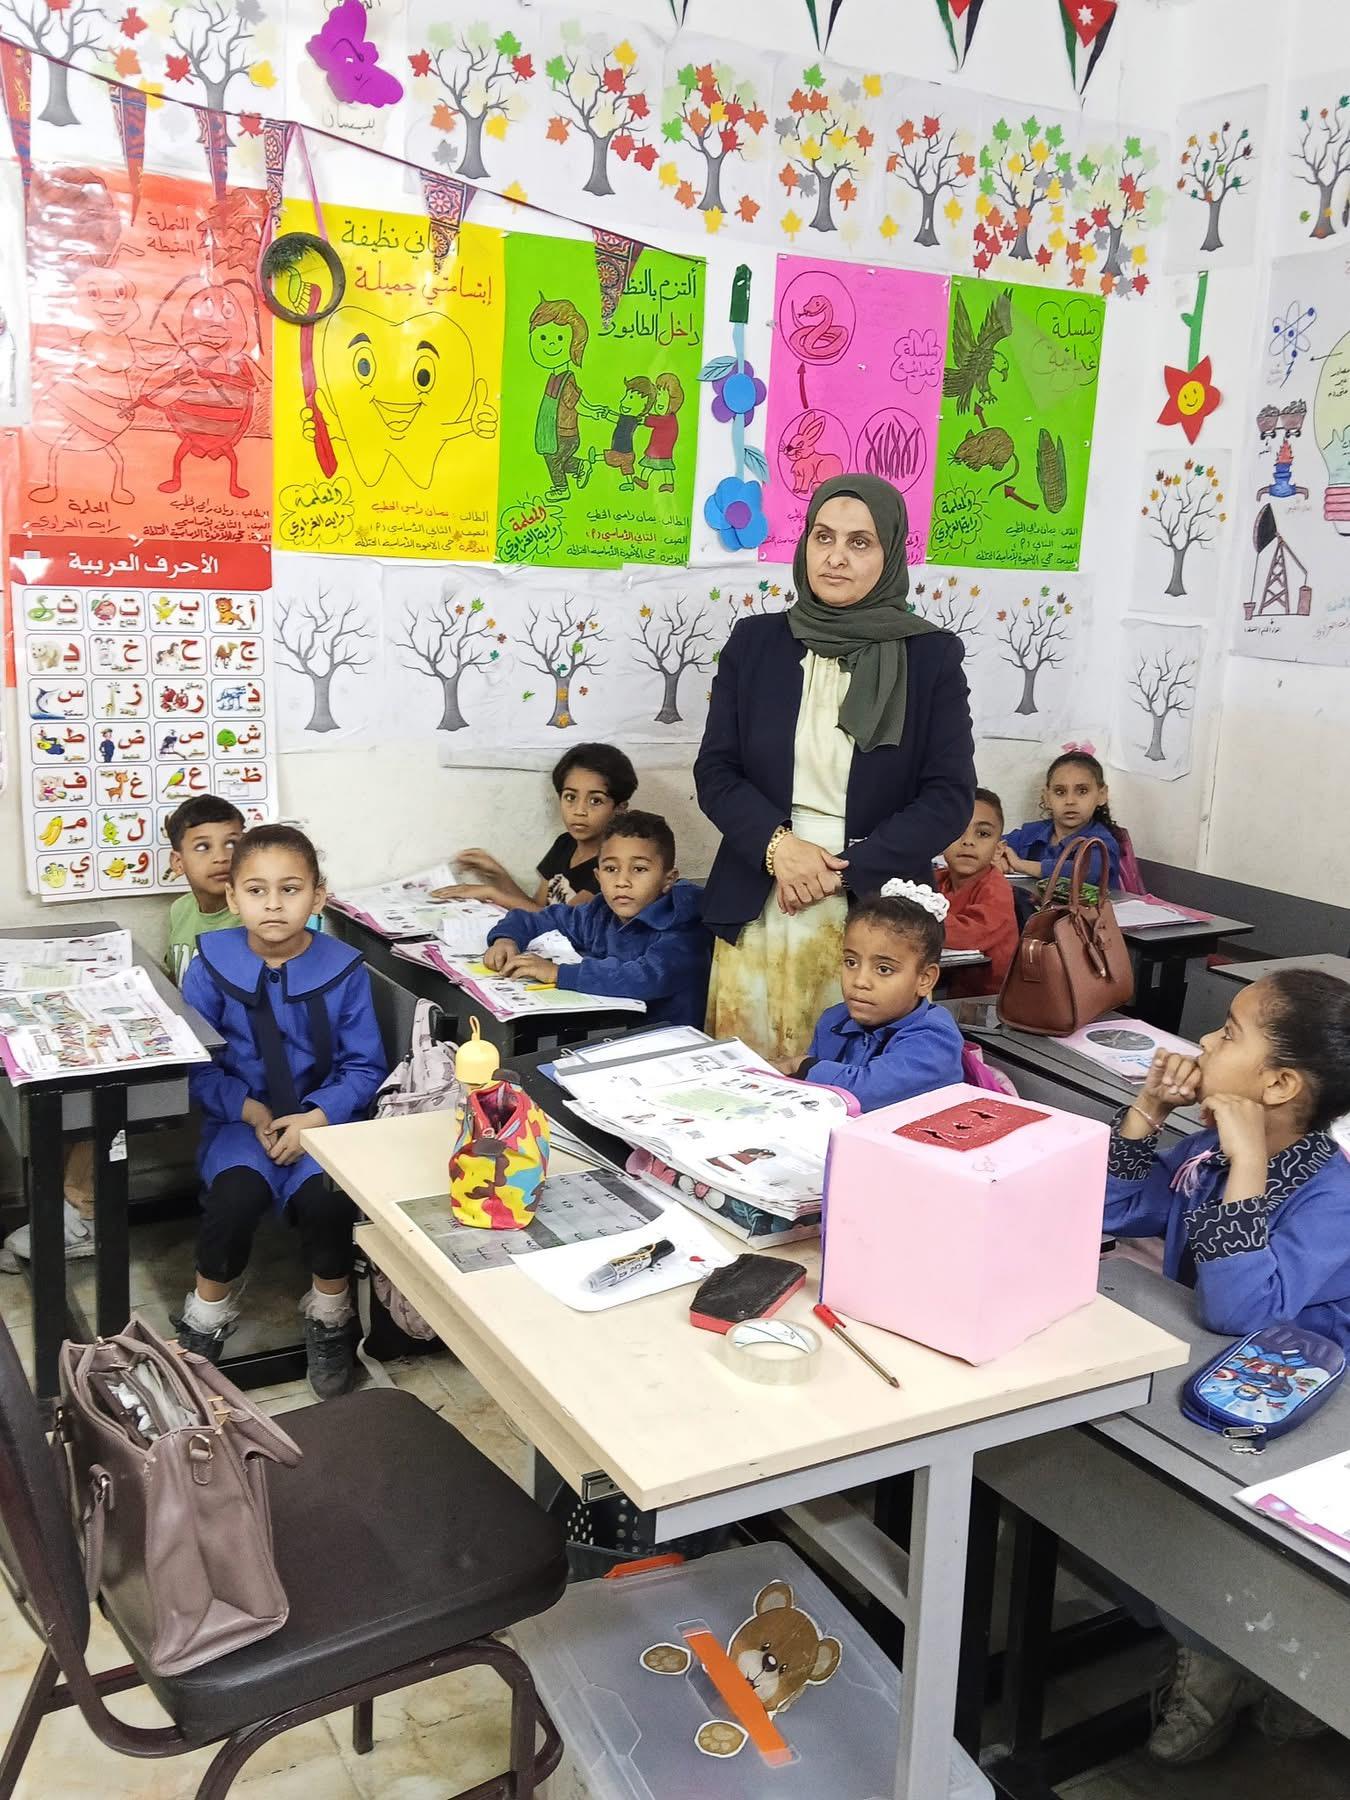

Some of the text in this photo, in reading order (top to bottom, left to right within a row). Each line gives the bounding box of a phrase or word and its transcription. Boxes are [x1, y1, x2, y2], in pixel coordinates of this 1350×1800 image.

[341, 218, 400, 253] نظيفة
[354, 260, 416, 297] جميلة
[623, 268, 657, 301] بالنظ
[597, 310, 659, 342] الطابور
[1052, 316, 1096, 338] سلسلة
[903, 338, 938, 357] سلسلة
[67, 551, 219, 580] الأحرف العربية
[56, 594, 79, 614] ث
[118, 597, 141, 617] ت
[179, 600, 200, 617] ب
[249, 598, 257, 623] أ
[62, 642, 81, 662] د
[121, 639, 143, 663] خ
[180, 639, 203, 662] ح
[240, 640, 261, 662] ج
[57, 689, 85, 704] س
[124, 683, 143, 707] ز
[246, 682, 261, 703] ذ
[184, 694, 205, 714] ر
[62, 726, 86, 744] ط
[117, 728, 146, 750] ض
[178, 731, 205, 745] ص
[237, 724, 262, 746] ش
[62, 772, 88, 790] ف
[129, 771, 149, 799] غ
[188, 766, 208, 791] ع
[239, 766, 262, 783] ظ
[63, 816, 88, 830] م
[126, 816, 147, 842] ل
[69, 855, 90, 879] ي
[129, 851, 149, 874] و
